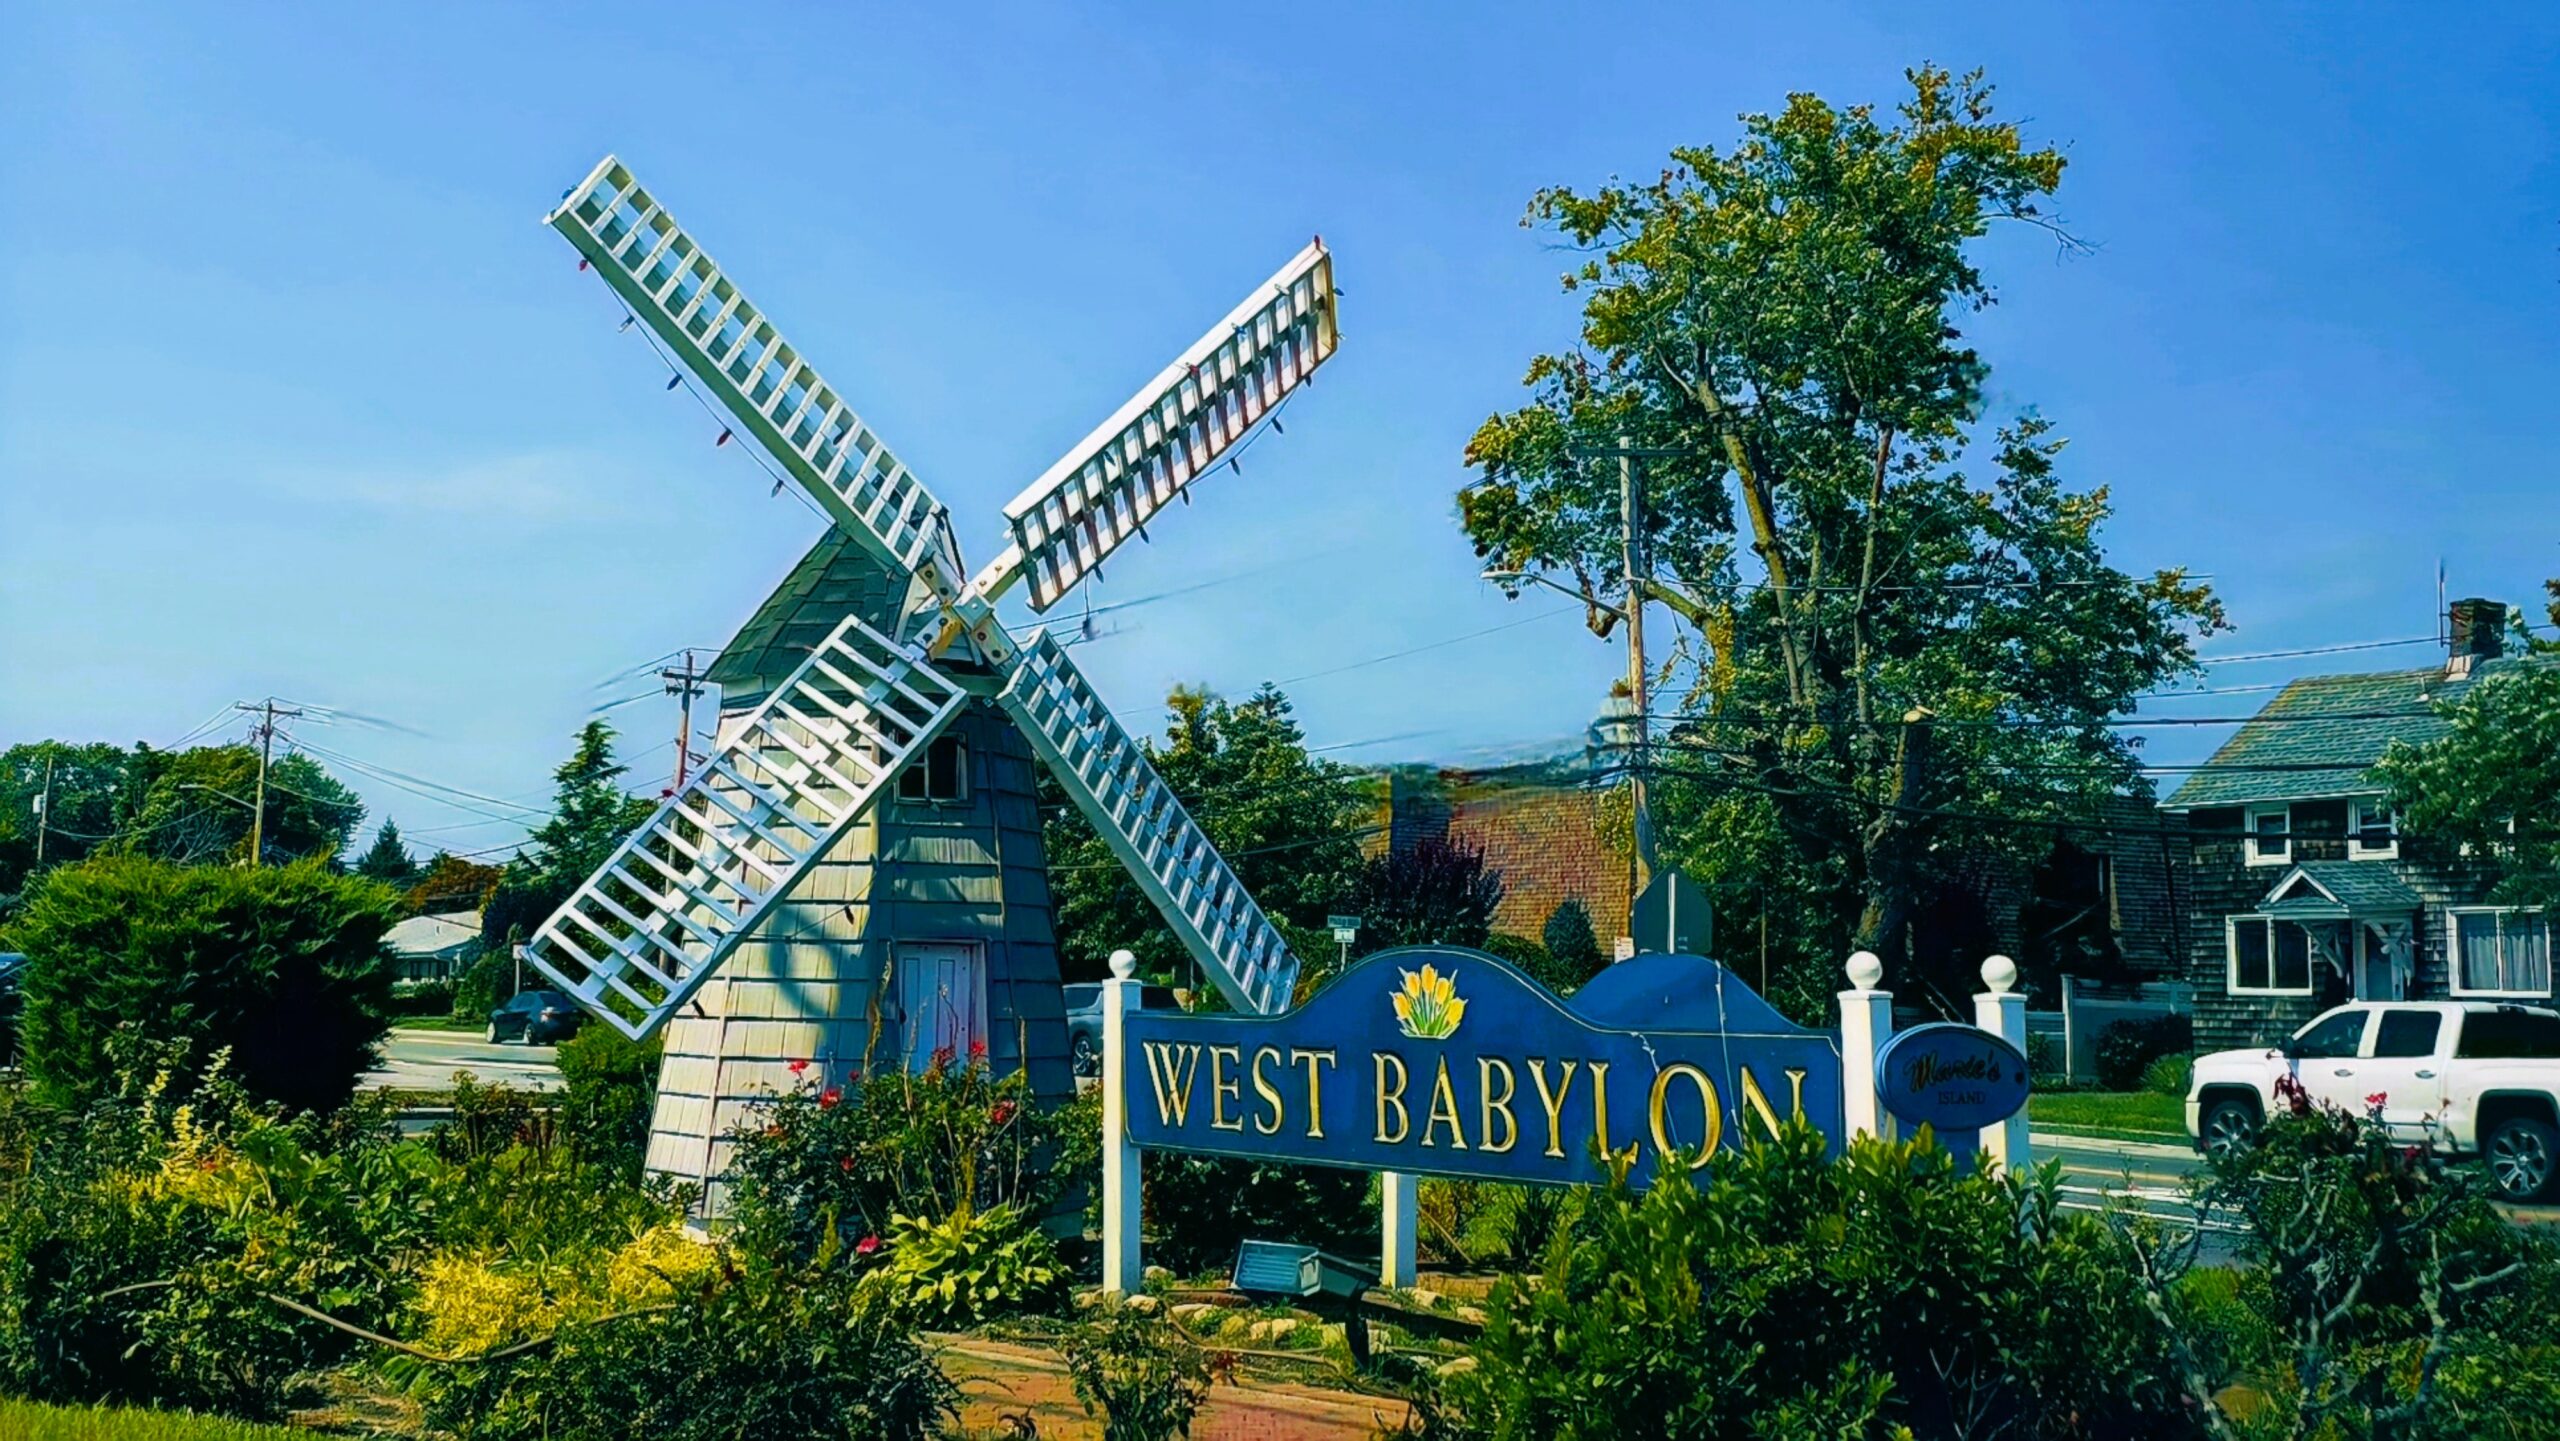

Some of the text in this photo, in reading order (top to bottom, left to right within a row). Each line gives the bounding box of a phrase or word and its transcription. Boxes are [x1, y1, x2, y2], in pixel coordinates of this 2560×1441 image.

[1142, 1041, 1807, 1169] WEST BABYLON
[1938, 1091, 1986, 1104] ISLAND
